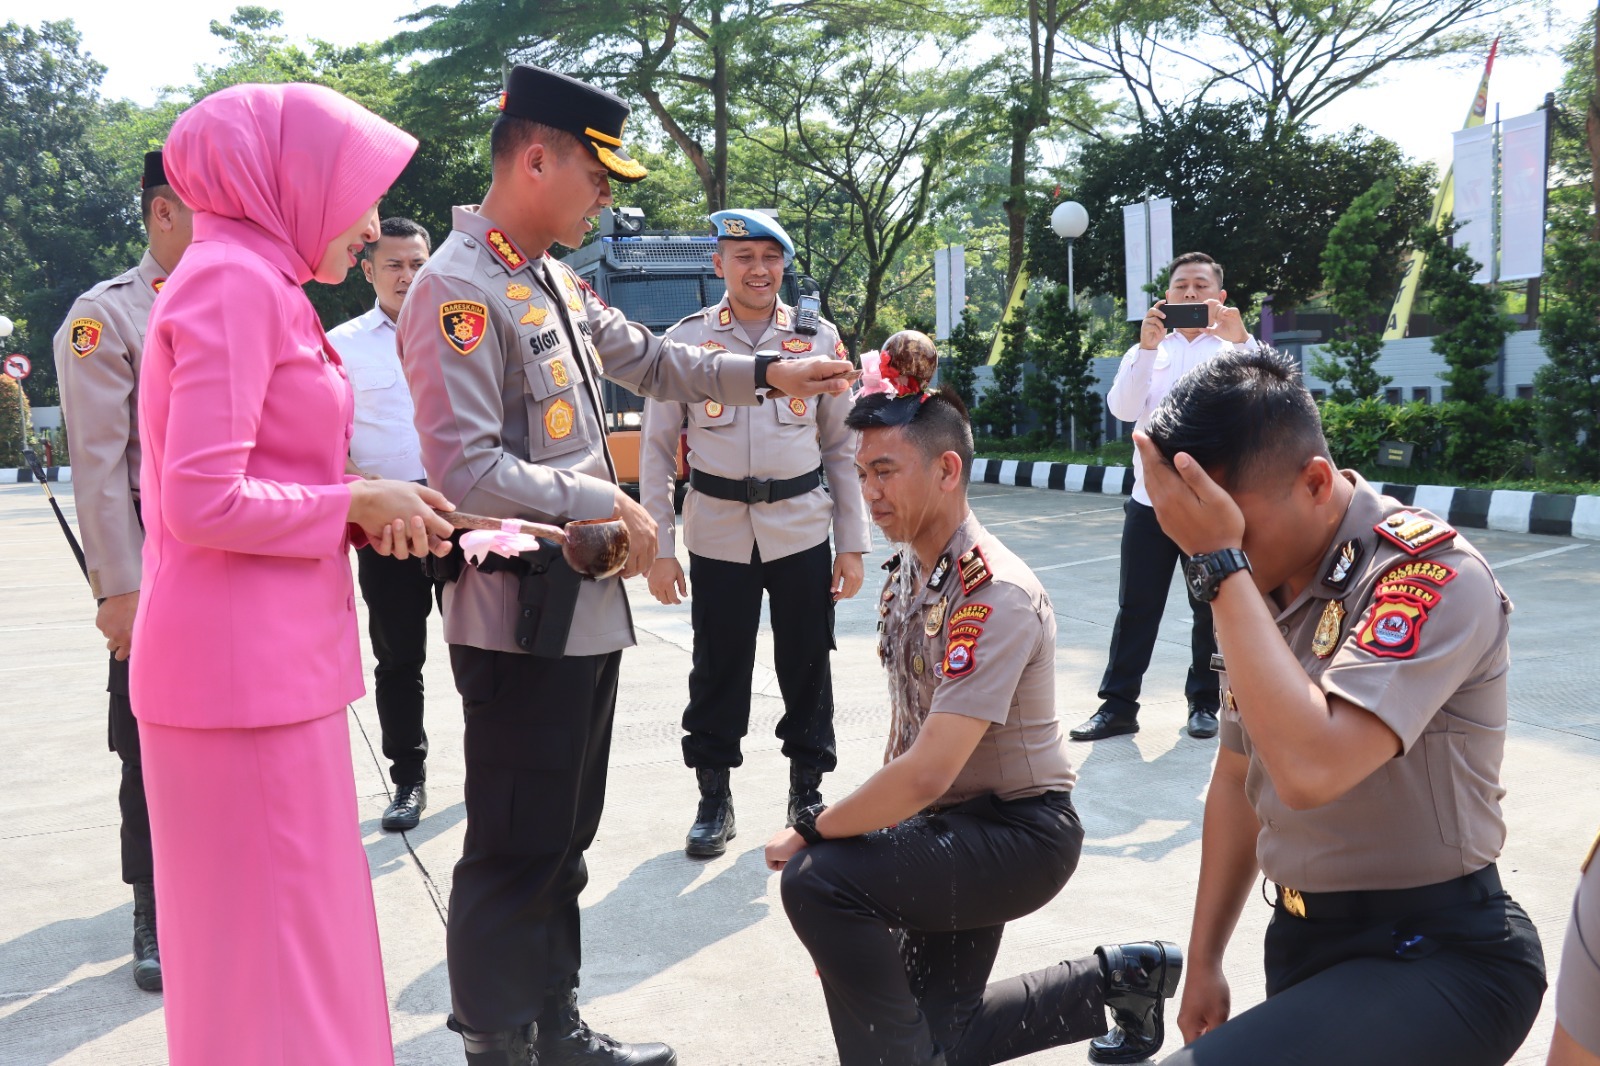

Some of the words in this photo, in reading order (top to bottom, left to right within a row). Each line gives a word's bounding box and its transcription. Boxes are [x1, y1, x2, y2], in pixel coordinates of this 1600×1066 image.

[444, 303, 483, 314] BARESKRIM
[529, 328, 560, 355] SIGIT
[1381, 562, 1447, 584] POLRESTA
[1386, 568, 1444, 582] ANGERANG
[1381, 584, 1433, 602] BANTEN
